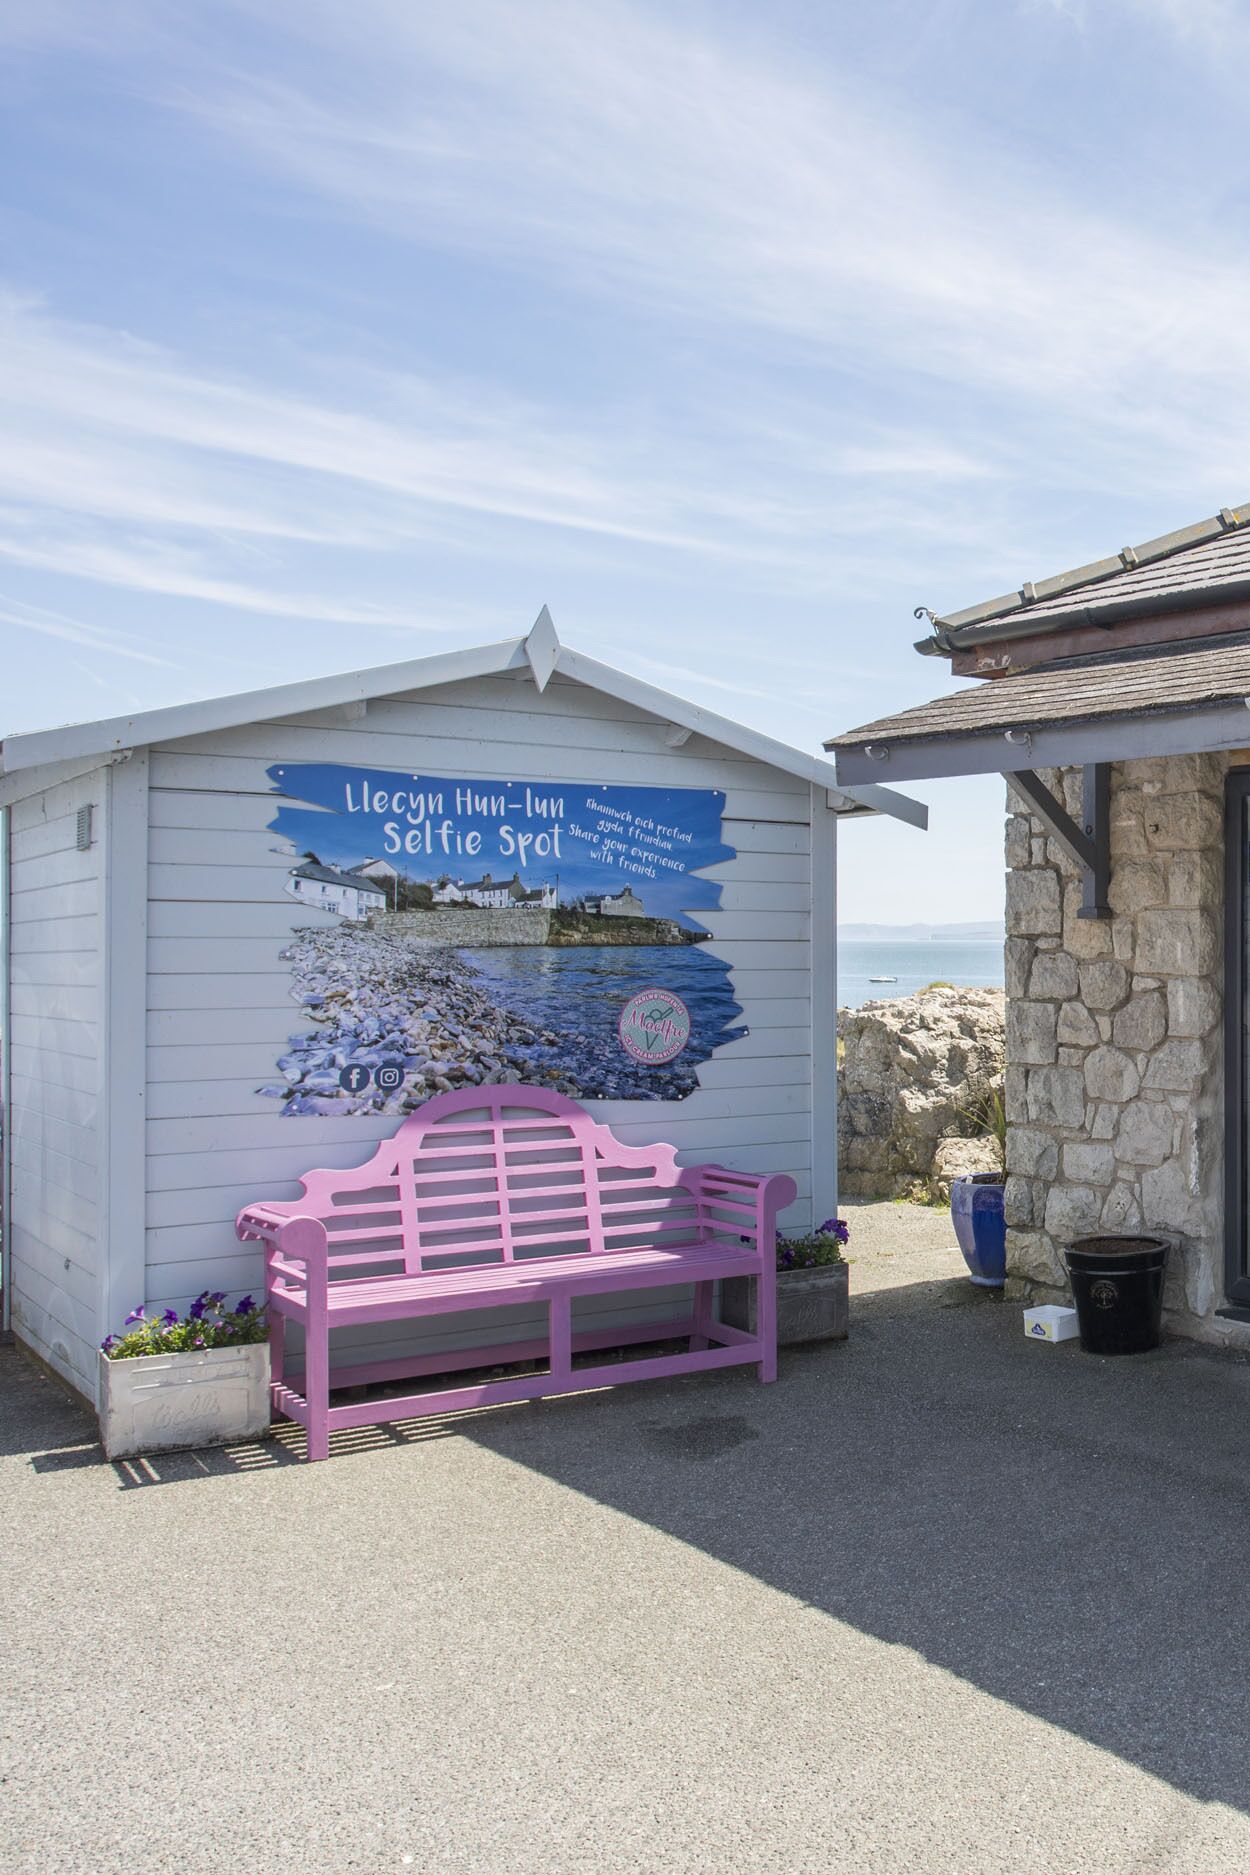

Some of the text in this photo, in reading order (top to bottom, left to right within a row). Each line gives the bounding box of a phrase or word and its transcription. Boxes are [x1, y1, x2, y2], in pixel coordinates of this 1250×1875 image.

[345, 780, 564, 825] Llecyn Hun-lun
[383, 820, 564, 868] Selfie Spot
[596, 819, 624, 835] gyda
[656, 824, 693, 844] profiad
[568, 823, 686, 872] Share your experience
[590, 849, 657, 879] with friends.
